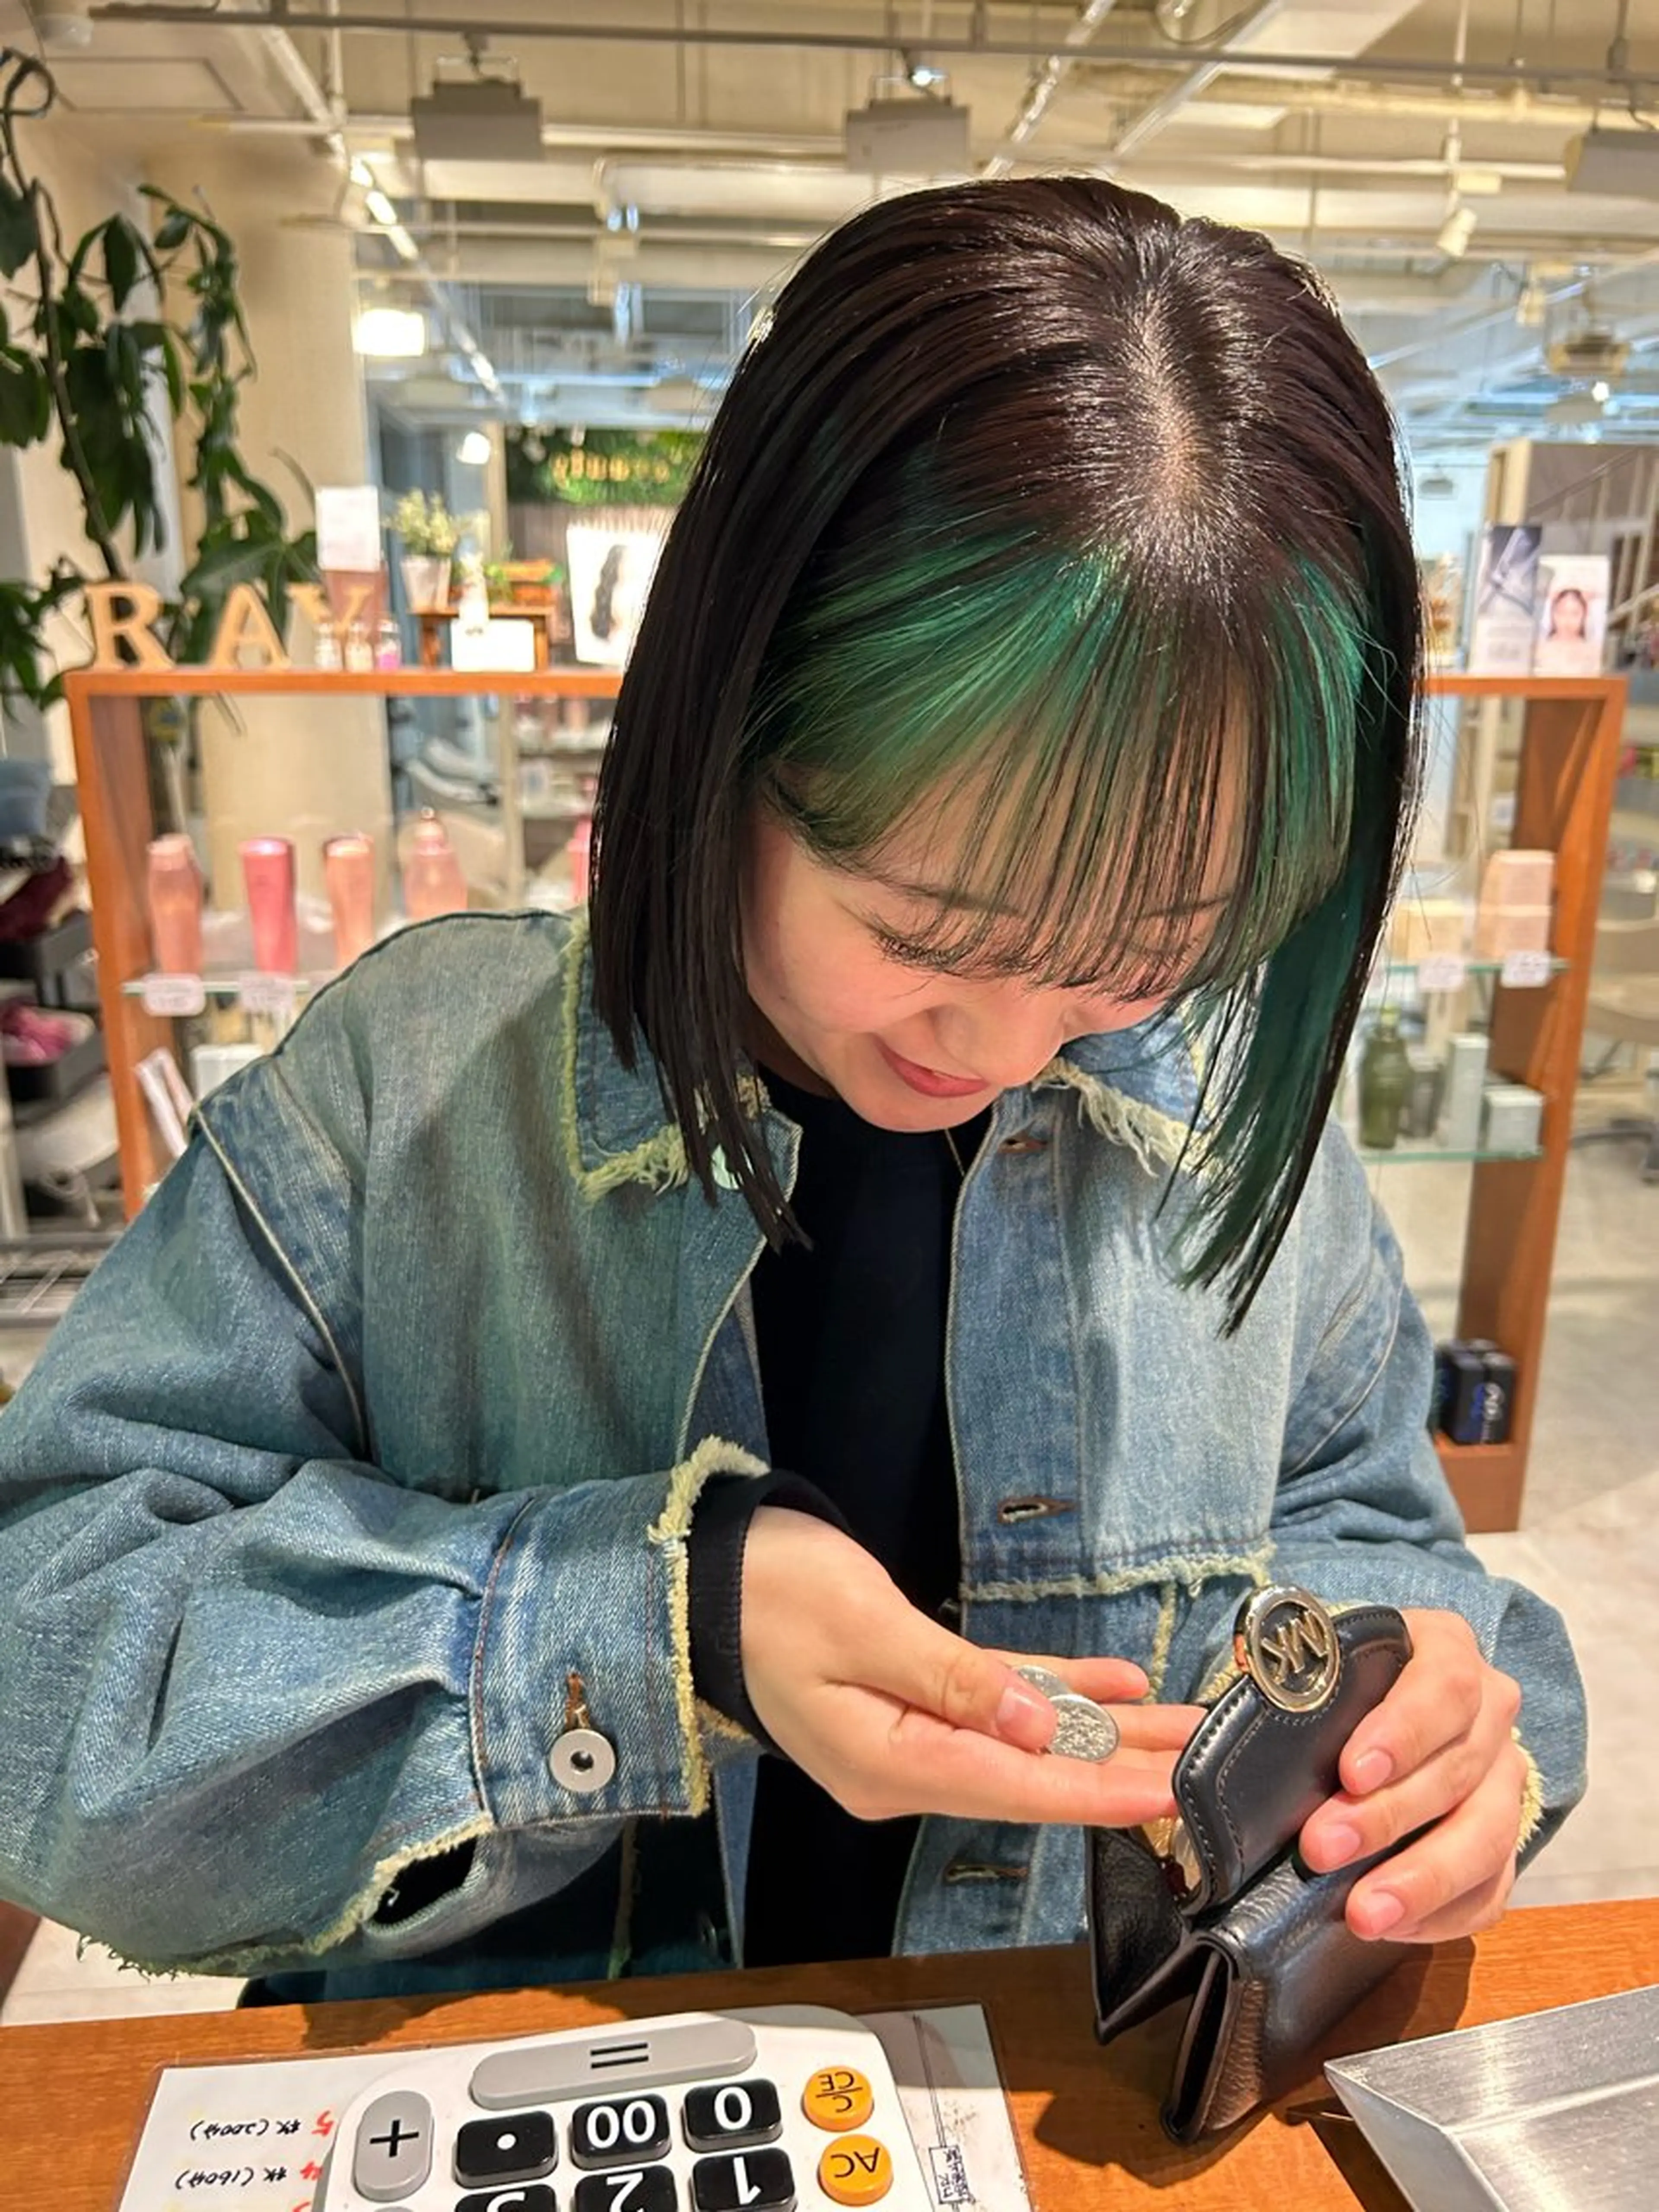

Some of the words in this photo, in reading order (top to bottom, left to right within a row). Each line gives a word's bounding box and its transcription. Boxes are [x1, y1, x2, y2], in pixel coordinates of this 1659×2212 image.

[818, 2071, 854, 2092] CE
[715, 2087, 751, 2129] 0
[833, 2095, 852, 2113] C
[588, 2101, 655, 2148] 00
[734, 2157, 760, 2204] 1
[830, 2147, 879, 2178] AC
[607, 2172, 642, 2212] 2
